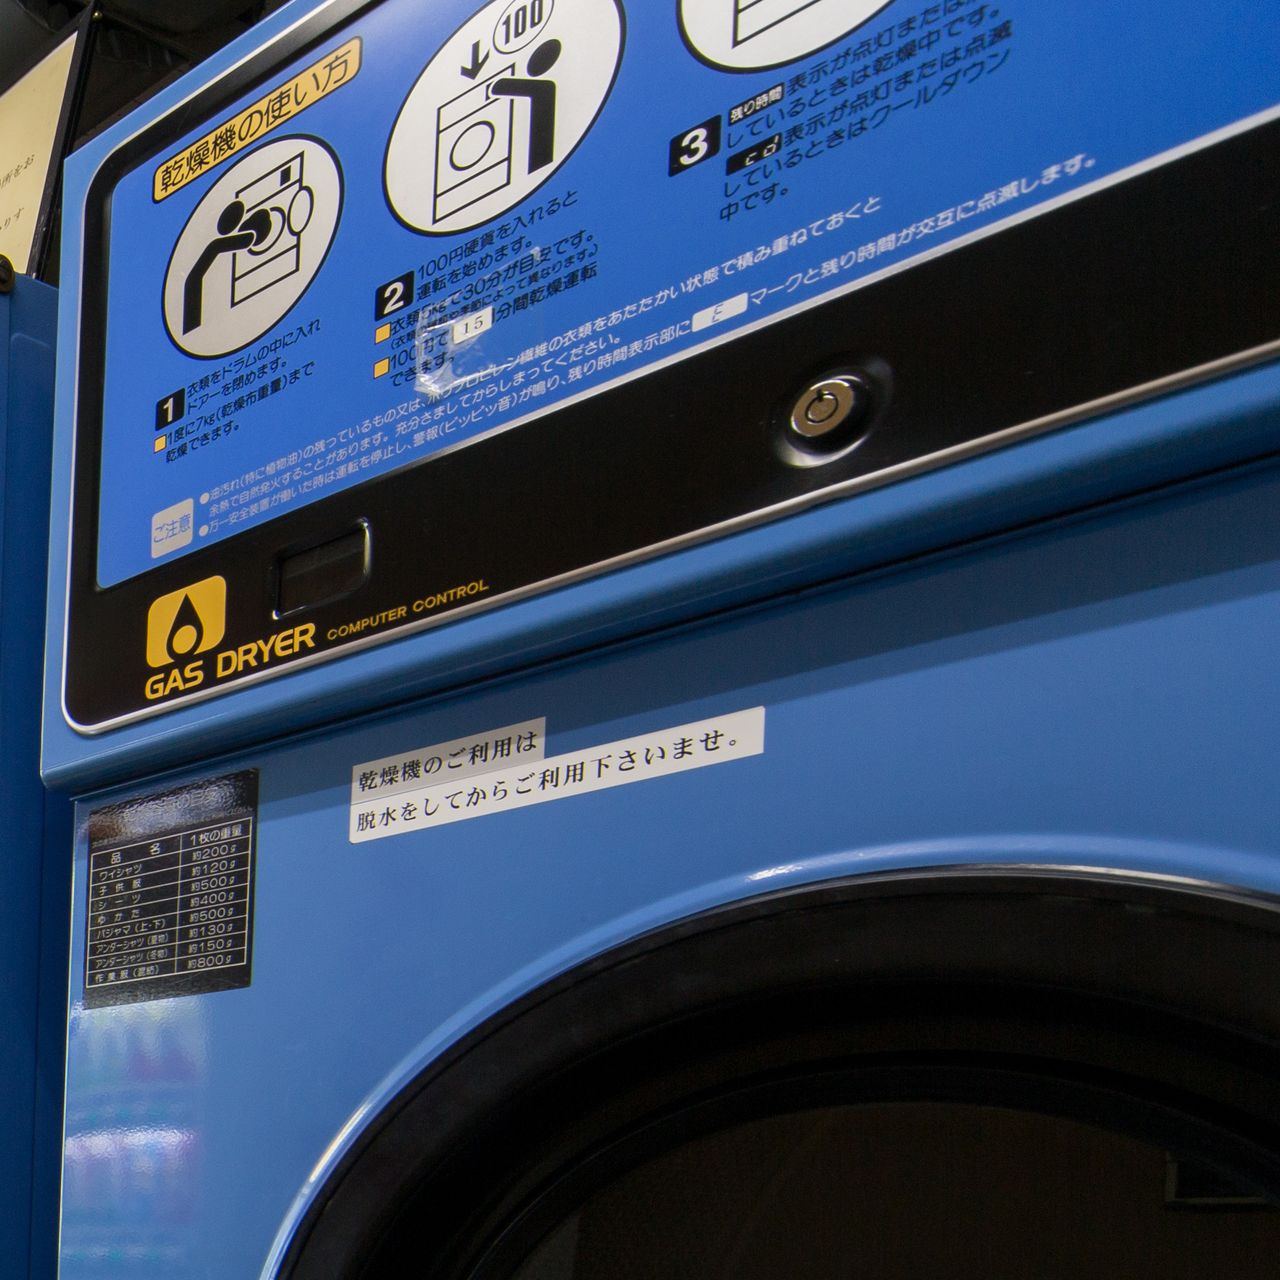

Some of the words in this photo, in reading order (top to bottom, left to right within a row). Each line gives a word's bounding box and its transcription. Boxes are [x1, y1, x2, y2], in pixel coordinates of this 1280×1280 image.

[502, 0, 544, 45] 100
[727, 9, 1000, 149] しているときは乾燥中です。
[730, 85, 783, 123] 残り時間
[787, 0, 978, 95] 表示が点灯または
[785, 18, 1013, 148] 表示が点灯または点滅
[161, 49, 352, 193] 乾燥機の使い方
[679, 128, 708, 166] 3
[725, 48, 1010, 198] しているときはクールダウン
[418, 191, 578, 280] 100円硬貨を入れると
[720, 186, 789, 222] 中です。
[383, 281, 404, 315] 2
[416, 235, 532, 301] 運転を始めます。
[464, 315, 484, 335] 15
[495, 263, 598, 323] 分間乾燥運転
[187, 318, 321, 397] 衣類をドラムの中に入れ
[187, 357, 287, 415] ドアーを閉めます。
[163, 398, 174, 423] 1
[166, 419, 239, 463] 乾燥できます。
[153, 513, 191, 543] ご注意
[144, 660, 205, 700] GAS
[216, 622, 317, 679] DRYER
[327, 606, 407, 641] COMPUTER
[412, 579, 490, 613] CONTROL
[355, 728, 739, 832] 脱水をしてからご利用下さいませ。
[357, 730, 538, 793] 乾燥機のご利用は
